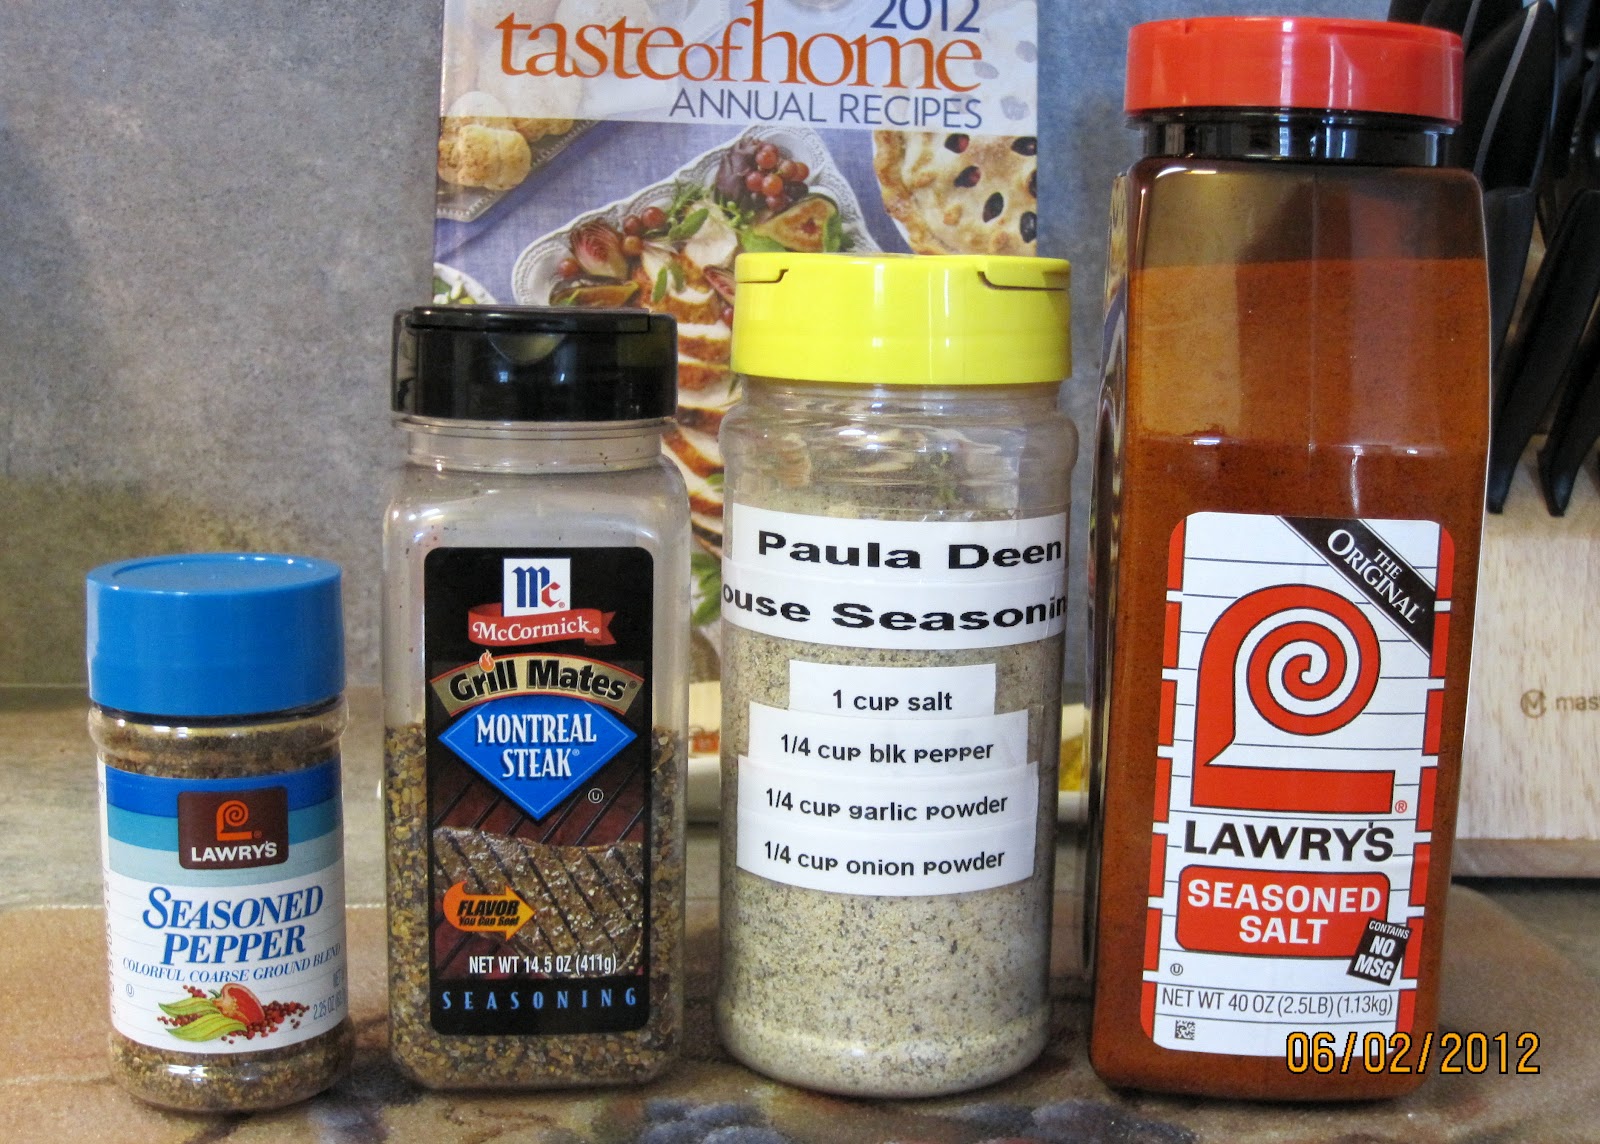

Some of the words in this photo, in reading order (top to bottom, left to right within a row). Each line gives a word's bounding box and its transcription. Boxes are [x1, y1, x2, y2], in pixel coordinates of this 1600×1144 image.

[870, 0, 980, 33] 2012
[669, 87, 827, 123] ANNUAL
[839, 92, 983, 129] RECIPES
[758, 530, 922, 570] Paula
[948, 540, 1062, 570] Deen
[1376, 548, 1402, 579] THE
[1327, 529, 1419, 624] ORIGINAL
[723, 583, 811, 623] ouse
[831, 595, 1066, 631] Seasonin
[472, 616, 592, 642] McCormick
[450, 657, 518, 702] Grill
[527, 659, 627, 701] Mates
[832, 689, 843, 709] 1
[853, 696, 900, 712] cup
[908, 691, 953, 711] salt
[1556, 694, 1600, 711] mas
[476, 713, 598, 744] MONTREAL
[502, 747, 573, 778] STEAK
[780, 733, 812, 757] 1/4
[817, 743, 862, 762] cup
[869, 744, 908, 764] blk
[914, 742, 995, 763] pepper
[765, 788, 794, 812] 1/4
[800, 797, 841, 817] cup
[848, 801, 918, 822] garlic
[926, 795, 1009, 821] powder
[191, 841, 278, 863] LAWRY'S
[1183, 819, 1395, 863] LAWRY'S
[764, 840, 792, 864] 1/4
[797, 852, 838, 871] cup
[846, 857, 915, 876] onion
[922, 850, 1006, 876] powder
[142, 884, 324, 931] SEASONED
[457, 900, 521, 917] FLAVOR
[1187, 878, 1382, 914] SEASONED
[1239, 915, 1329, 945] SALT
[1368, 919, 1410, 939] CONTAINS
[159, 924, 307, 966] PEPPER
[1369, 935, 1396, 957] NO
[122, 956, 186, 982] COLORFUL
[189, 968, 250, 983] COARSE
[253, 956, 311, 980] GROUND
[313, 942, 341, 967] BLEND
[469, 956, 494, 974] NET
[499, 956, 520, 974] WT
[524, 956, 552, 974] 14.5
[556, 956, 572, 974] OZ
[575, 953, 617, 975] (411g)
[1353, 954, 1395, 981] MSG
[442, 987, 637, 1010] SEASONING
[1161, 987, 1194, 1008] NET
[1198, 989, 1224, 1010] WT
[1228, 991, 1249, 1012] 40
[1252, 992, 1275, 1014] OZ
[1277, 993, 1334, 1017] (2.5LB)
[1336, 993, 1393, 1017] (1.13kg)
